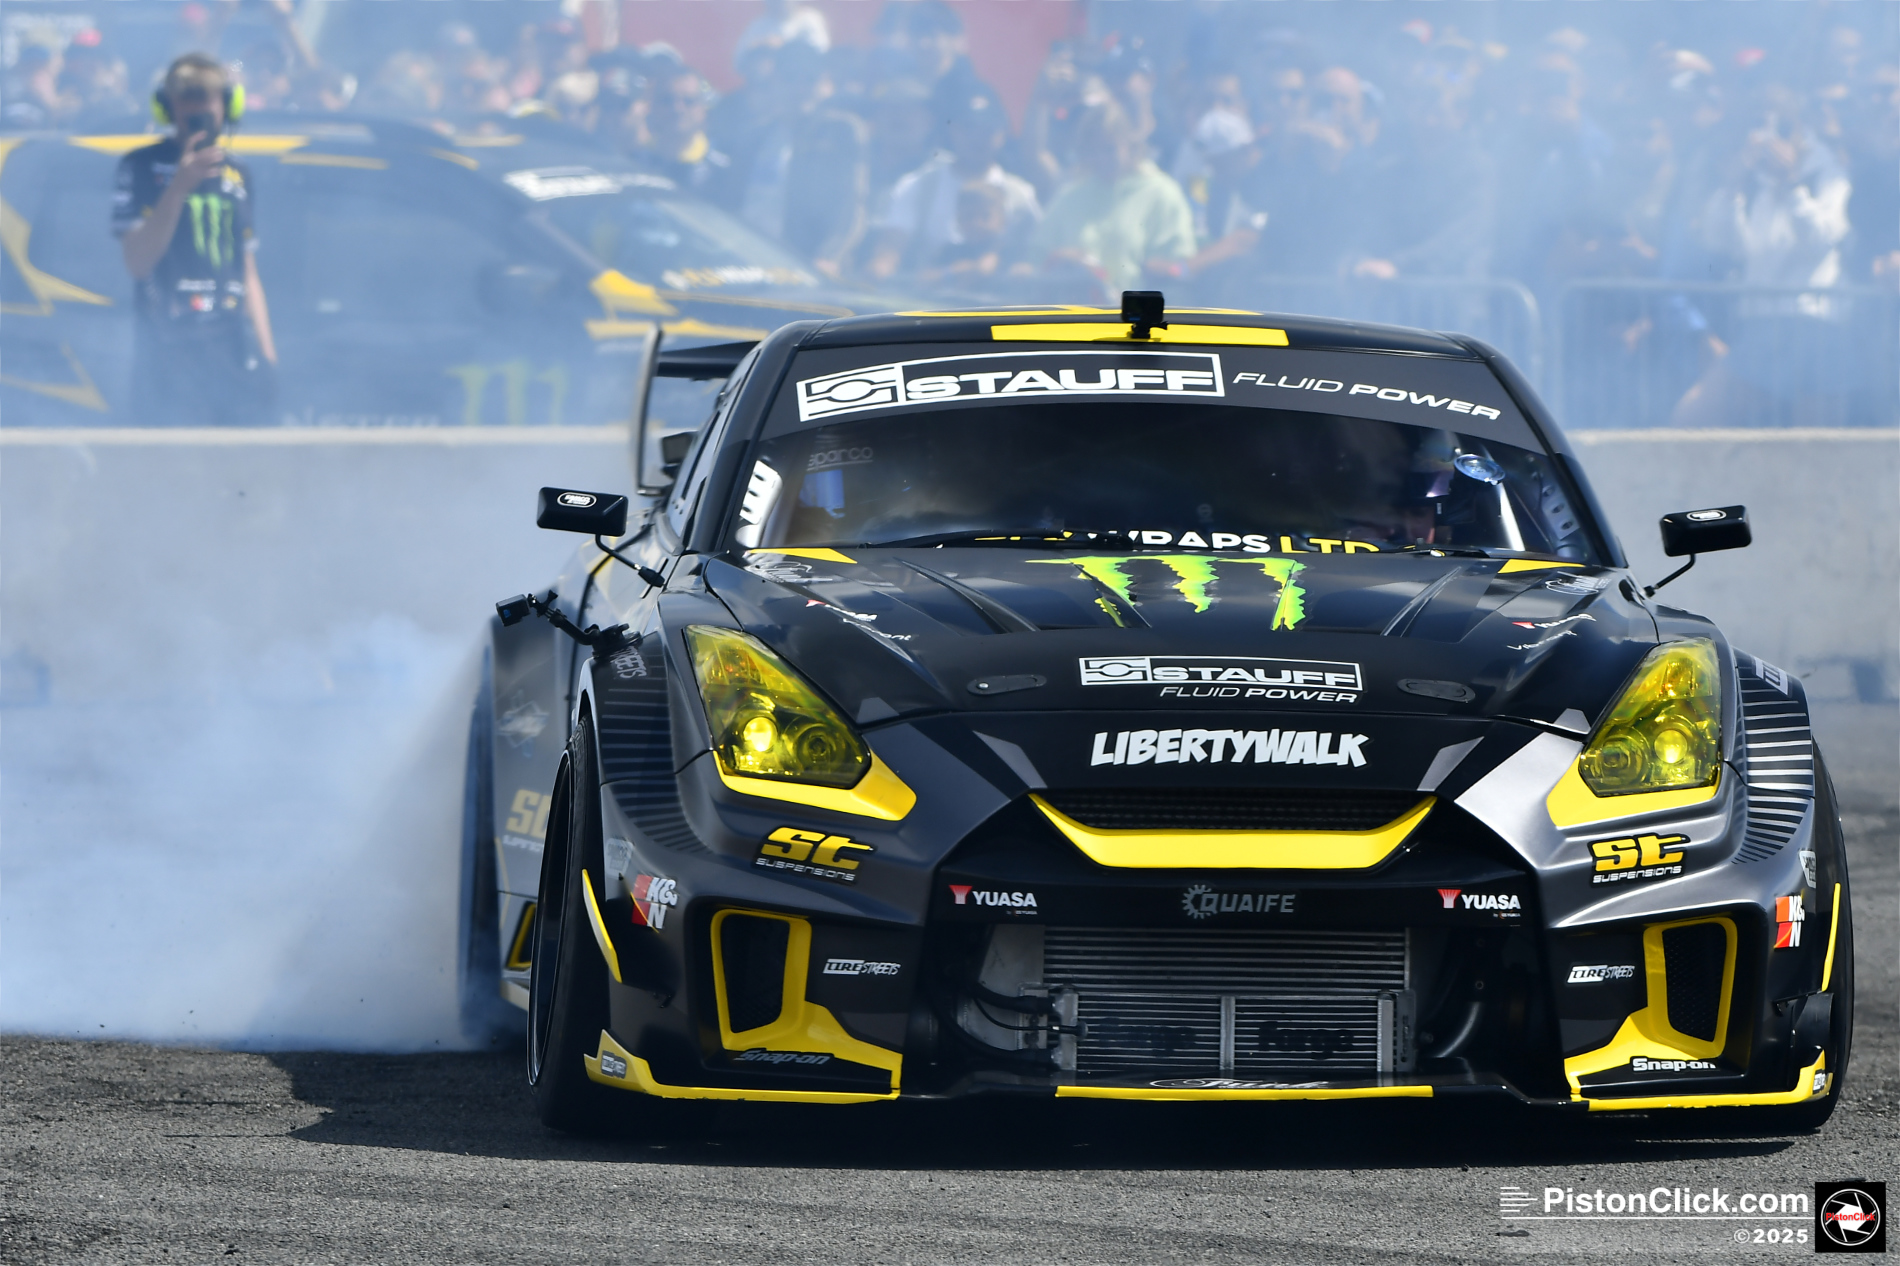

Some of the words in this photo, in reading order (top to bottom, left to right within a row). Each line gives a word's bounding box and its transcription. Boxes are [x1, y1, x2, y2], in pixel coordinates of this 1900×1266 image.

[905, 369, 1213, 399] STAUFF
[1233, 372, 1344, 392] FLUID
[1349, 383, 1501, 420] POWER
[1153, 666, 1356, 686] STAUFF
[1160, 686, 1240, 698] FLUID
[1244, 687, 1358, 703] POWER
[1090, 728, 1370, 768] LIBERTYWALK
[972, 891, 1038, 907] YUASA
[1200, 893, 1296, 914] QUAIFE
[1461, 894, 1521, 910] YUASA
[734, 1050, 830, 1065] Snap-on
[1632, 1058, 1717, 1072] Snap-on
